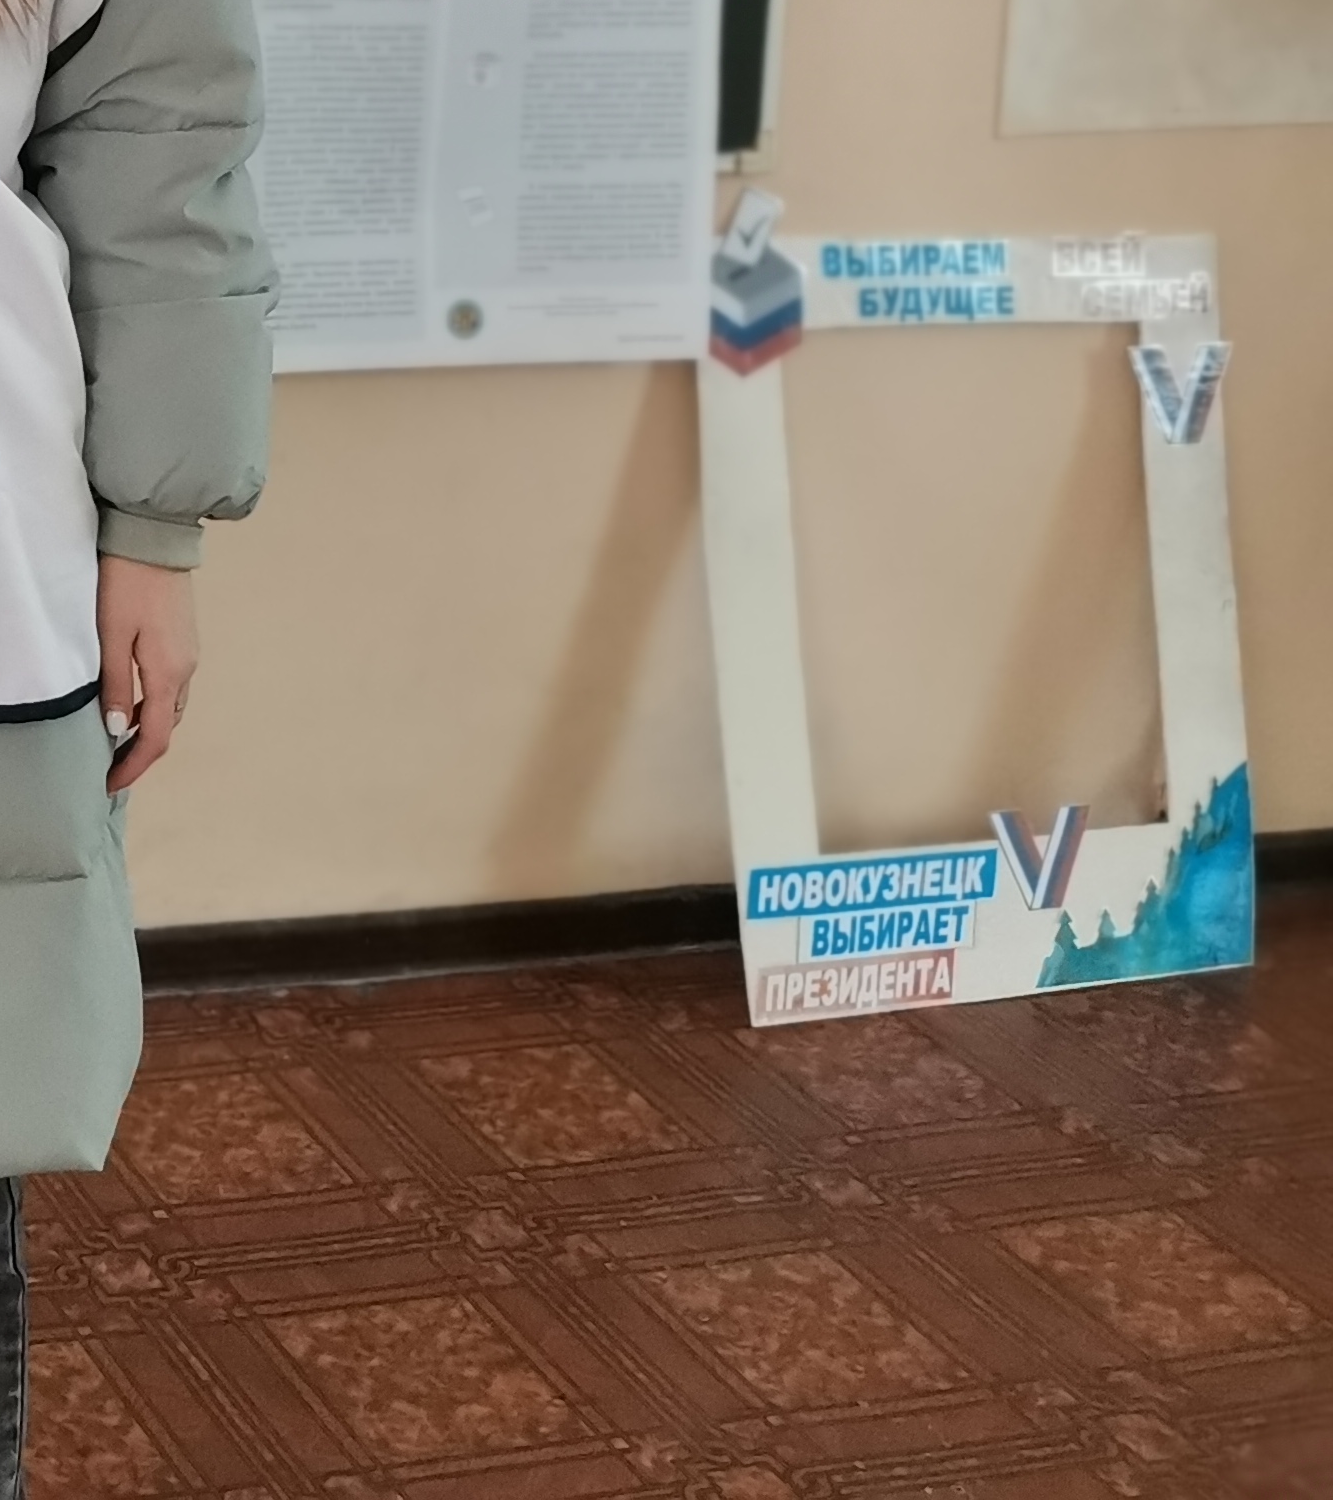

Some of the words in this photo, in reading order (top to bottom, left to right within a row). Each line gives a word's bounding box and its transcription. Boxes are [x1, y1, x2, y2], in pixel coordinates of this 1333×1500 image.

[821, 240, 1007, 279] ВЫБИРАЕМ
[858, 284, 1015, 322] БУДУЩЕЕ
[757, 855, 988, 914] НОВОКУЗНЕЦК
[809, 905, 970, 958] ВЫБИРАЕТ
[765, 955, 953, 1011] ПРЕЗИДЕНТА
